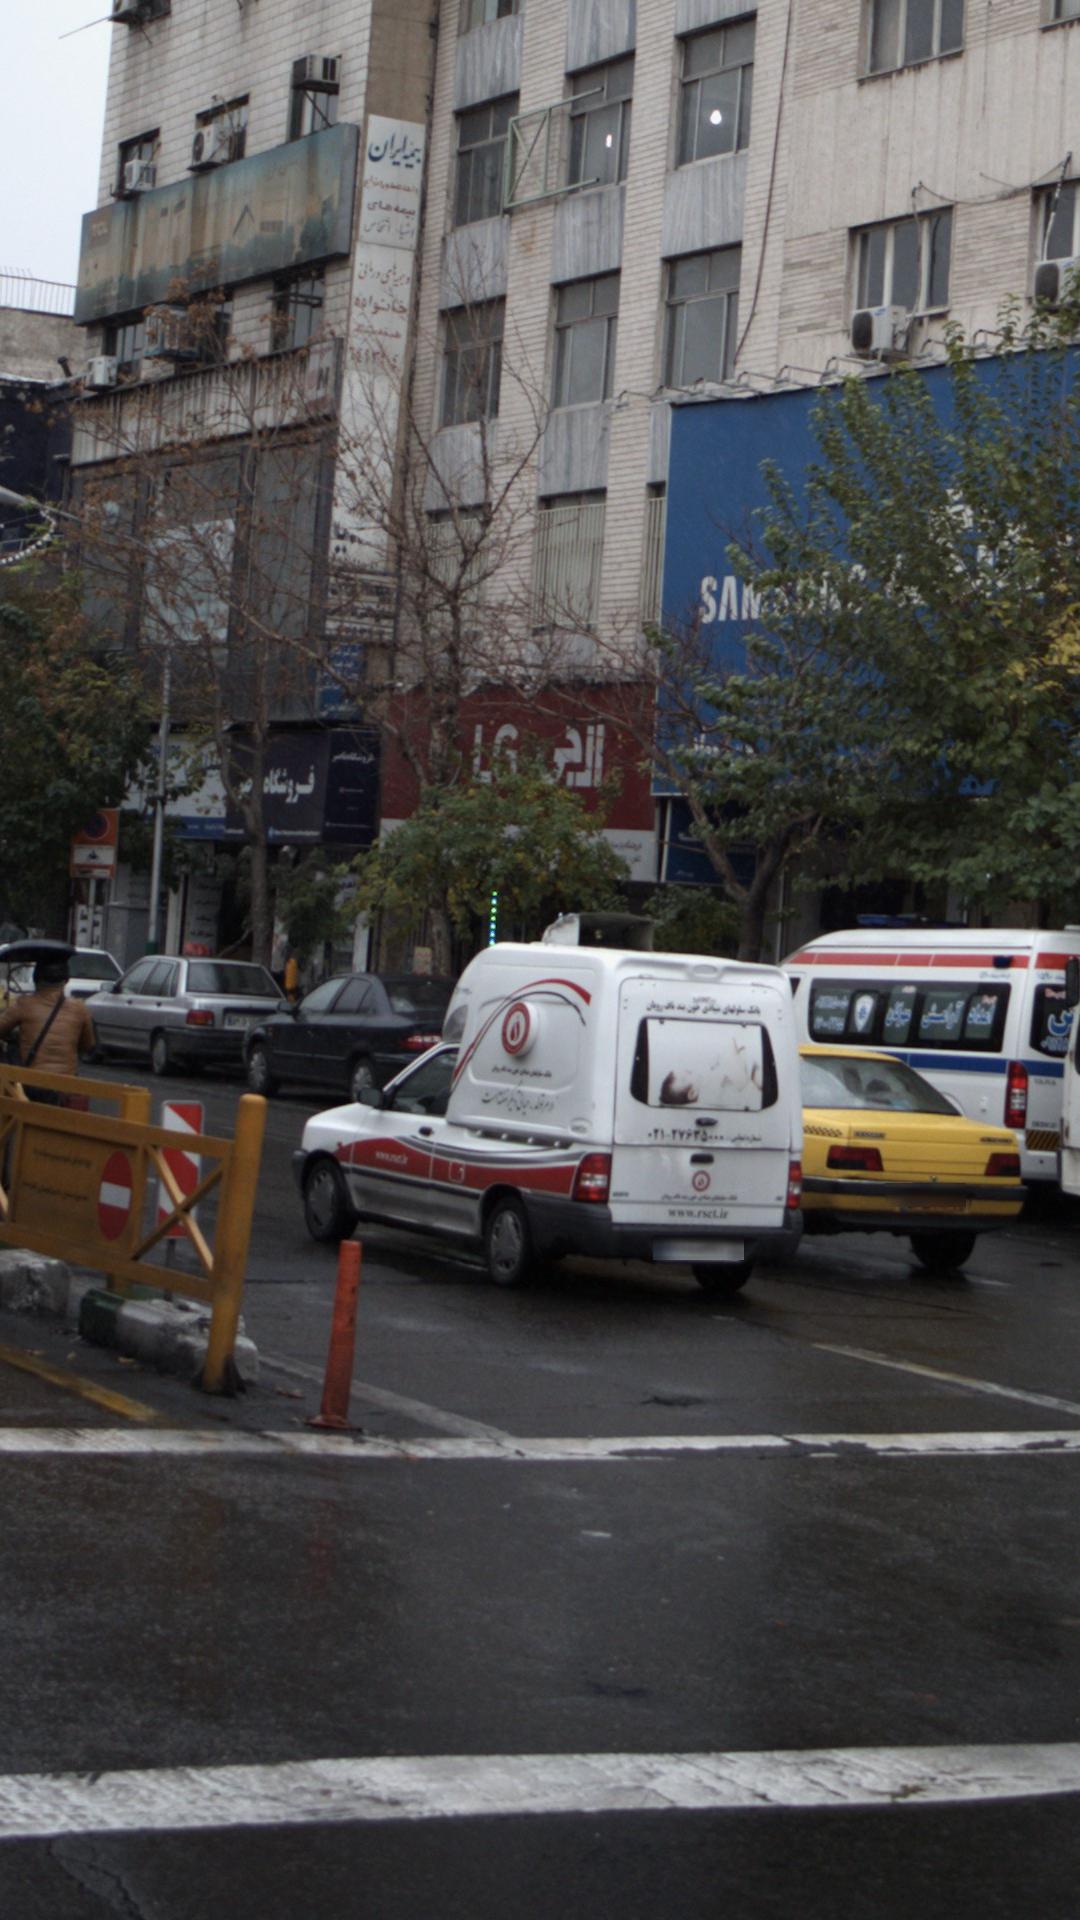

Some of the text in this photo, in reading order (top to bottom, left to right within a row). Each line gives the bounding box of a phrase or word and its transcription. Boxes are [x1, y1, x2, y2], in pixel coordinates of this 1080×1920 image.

[368, 132, 422, 168] بیمه ایران
[263, 764, 315, 804] فروشگاه
[747, 999, 761, 1015] بانک
